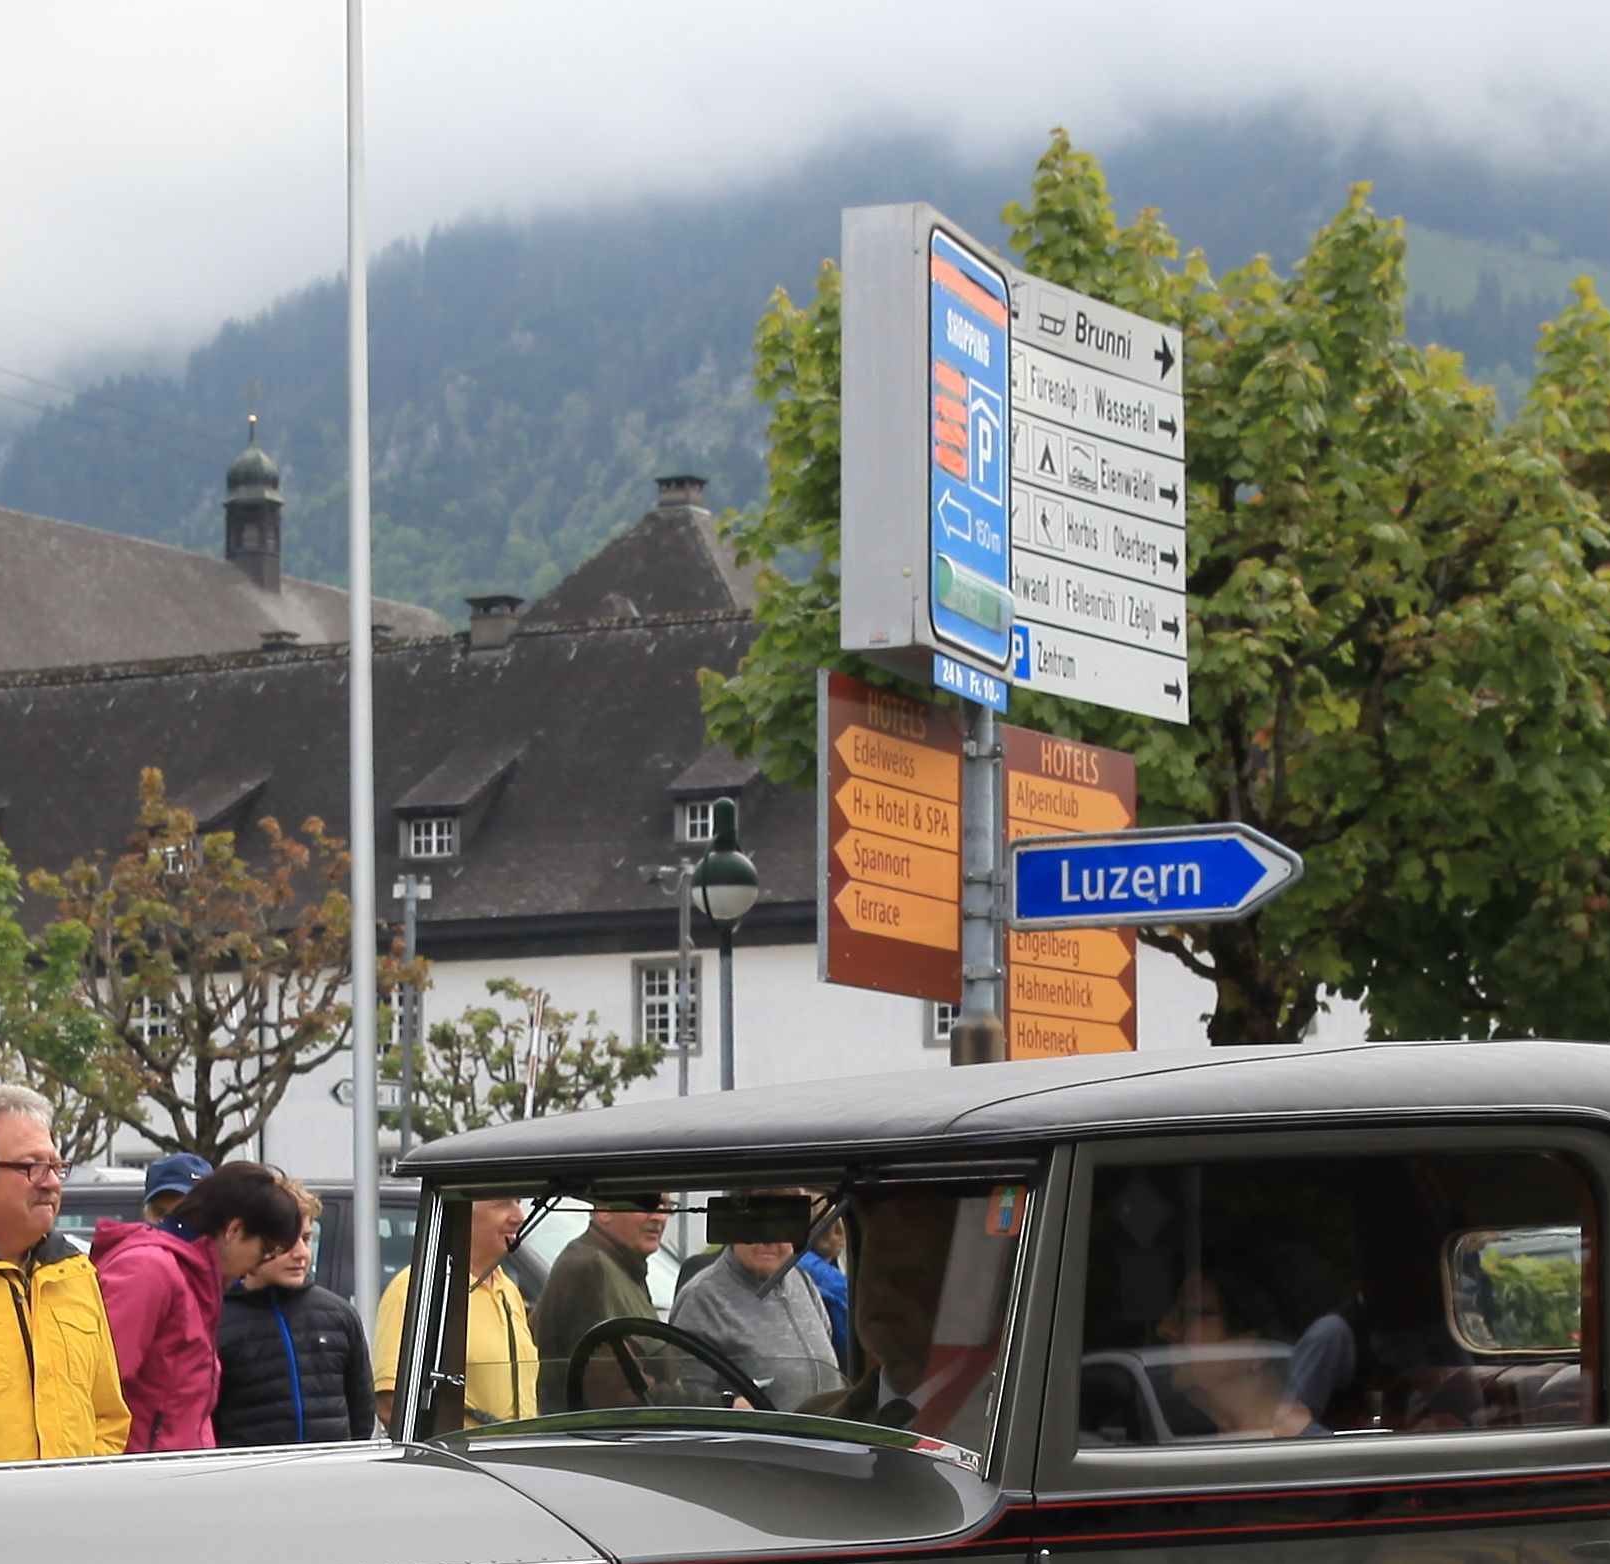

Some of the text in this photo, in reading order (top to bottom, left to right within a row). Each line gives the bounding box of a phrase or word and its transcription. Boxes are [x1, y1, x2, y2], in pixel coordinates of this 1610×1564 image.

[947, 308, 990, 367] SHOPPING
[1076, 311, 1132, 361] Brunni
[1094, 387, 1156, 434] Wasserfall
[1066, 512, 1098, 552] Horbis
[1113, 525, 1158, 576] Oberberg
[1012, 564, 1050, 606] hwand
[1065, 578, 1117, 623] Fellenrüti
[1037, 640, 1077, 680] Zentrum
[866, 690, 928, 741] HOTELS
[853, 734, 917, 780] Edelweiss
[1040, 740, 1100, 785] HOTELS
[853, 787, 951, 837] H+ Hotel & SPA
[1016, 781, 1079, 820] Alpenclub
[853, 838, 912, 881] Spannort
[1061, 858, 1201, 904] Luzern
[853, 890, 901, 928] Terrace
[1016, 931, 1080, 967] Engelberg
[1016, 973, 1094, 1009] Hahnenblick
[1016, 1020, 1080, 1056] Hoheneck
